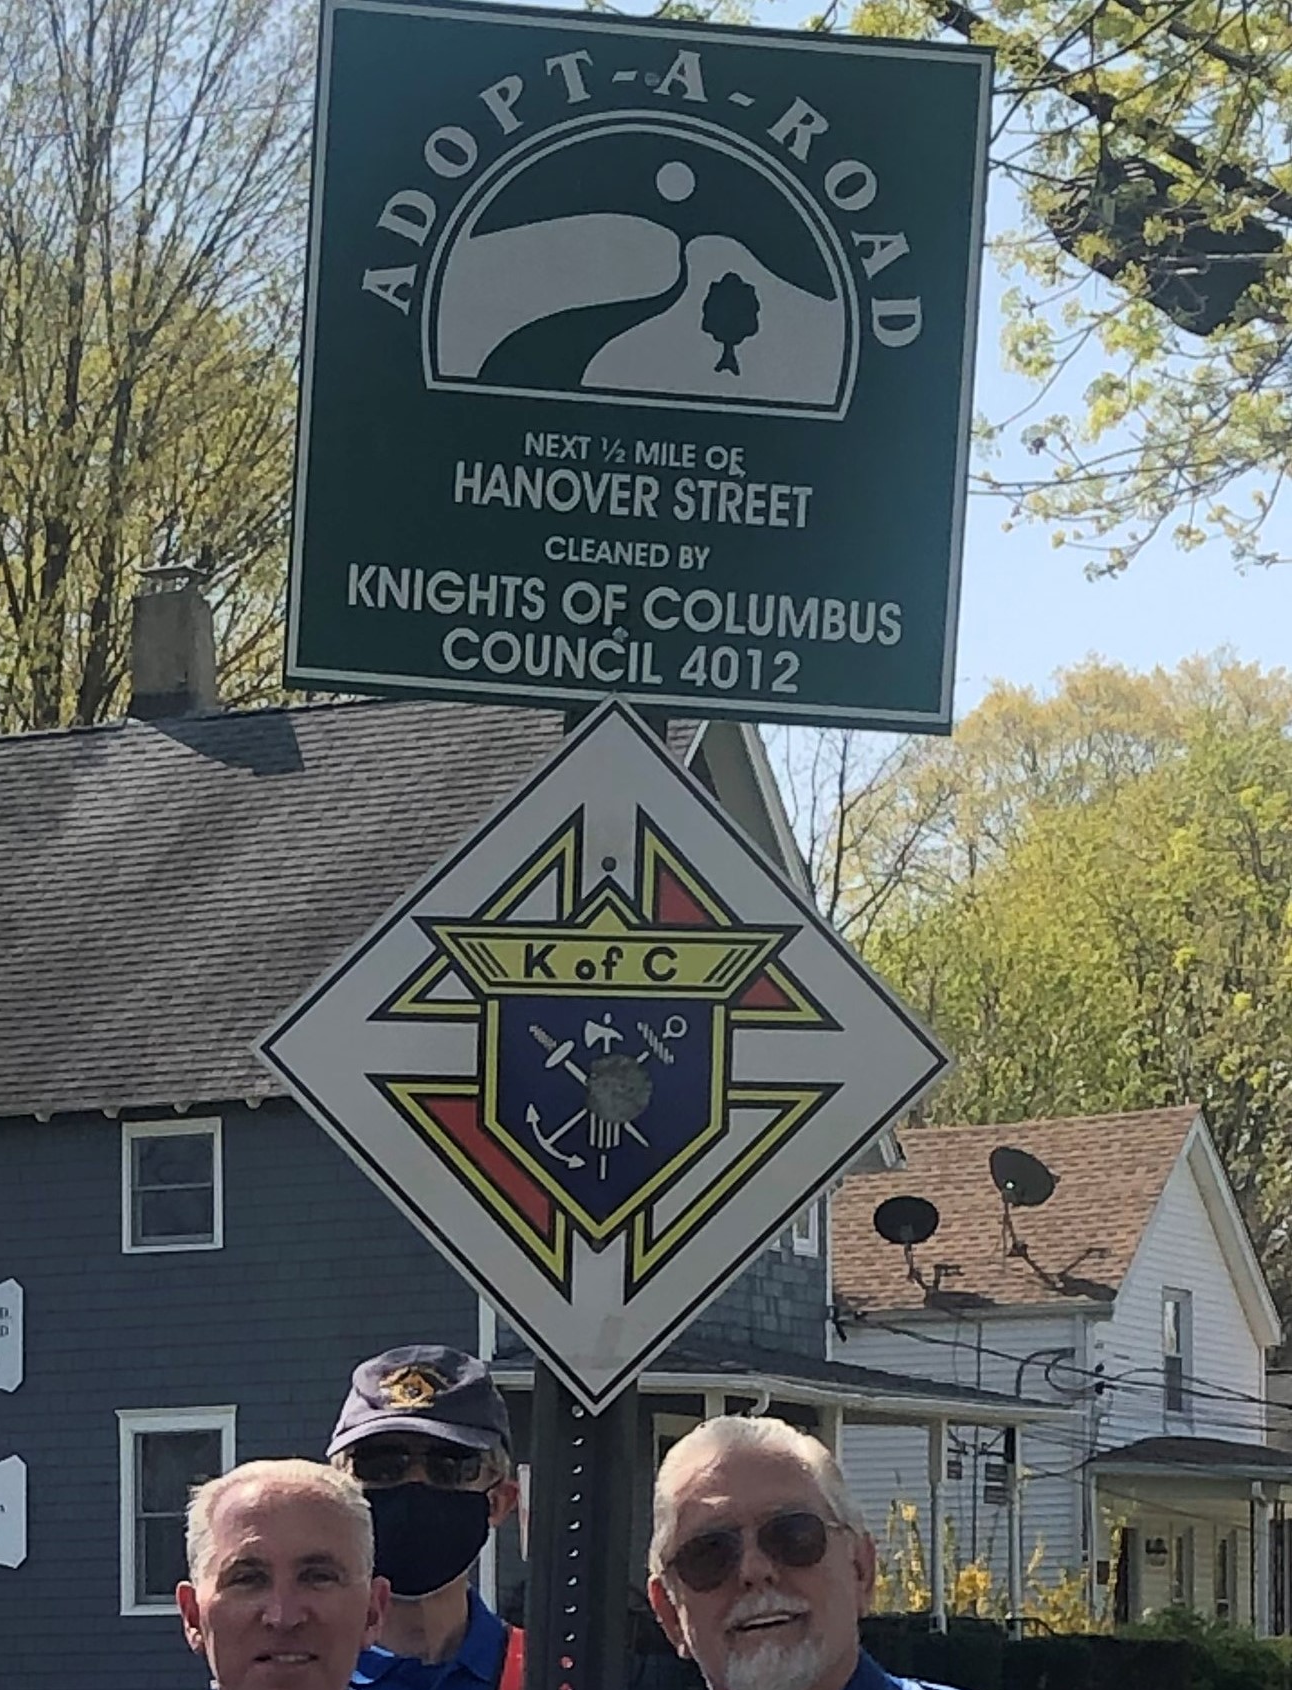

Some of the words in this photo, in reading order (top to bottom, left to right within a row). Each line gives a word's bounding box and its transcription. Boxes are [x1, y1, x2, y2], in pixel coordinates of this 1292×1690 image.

[362, 48, 922, 348] ADOPT-A-ROAD
[525, 432, 592, 460] NEXT
[635, 440, 696, 468] MILE
[705, 445, 746, 477] OF
[454, 460, 660, 518] HANOVER
[673, 477, 813, 528] STREET
[544, 536, 670, 568] CLEANED
[678, 545, 710, 570] BY
[348, 563, 545, 621] KNIGHTS
[562, 581, 628, 626] OF
[643, 586, 902, 646] COLUMBUS
[442, 627, 663, 685] COUNCIL
[680, 645, 801, 694] 4012
[523, 943, 556, 979] K
[575, 946, 624, 980] of
[642, 946, 678, 982] C
